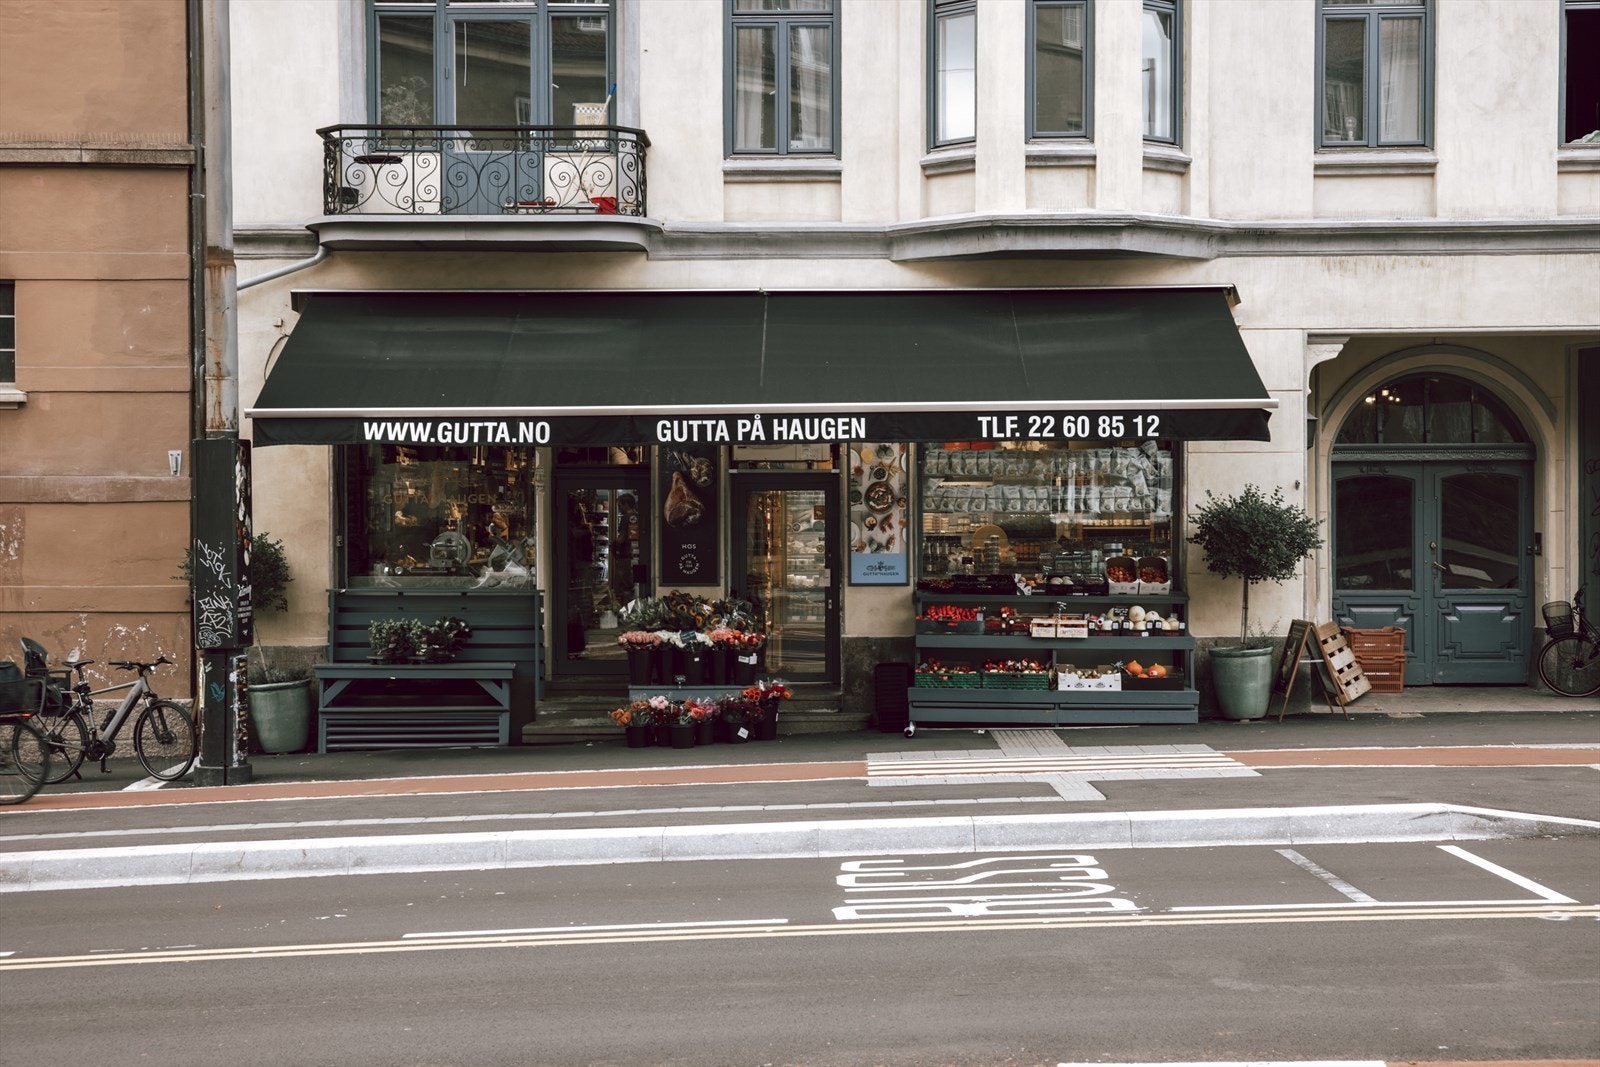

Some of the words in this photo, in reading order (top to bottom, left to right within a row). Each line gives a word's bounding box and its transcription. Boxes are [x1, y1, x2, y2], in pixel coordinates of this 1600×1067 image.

[364, 421, 550, 443] WWW.GUTTA.NO
[656, 420, 730, 442] GUTTA
[737, 414, 766, 441] PÅ
[773, 417, 866, 440] HAUGEN
[977, 416, 1020, 438] TLF.
[1028, 415, 1055, 438] 22
[1063, 415, 1090, 438] 60
[1098, 415, 1125, 437] 85
[1132, 415, 1160, 437] 12
